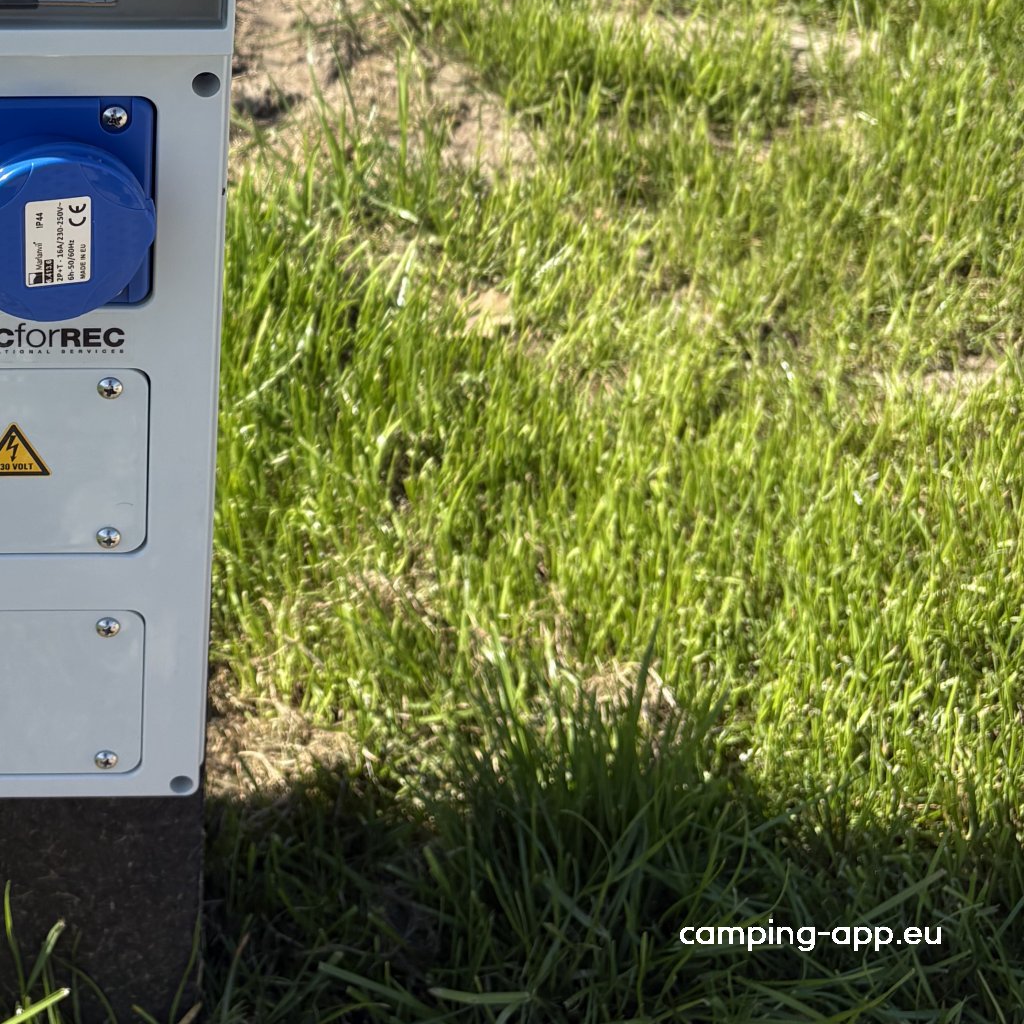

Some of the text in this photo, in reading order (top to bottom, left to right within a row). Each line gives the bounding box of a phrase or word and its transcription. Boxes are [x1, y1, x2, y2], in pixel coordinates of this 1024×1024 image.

[35, 212, 44, 229] IP44
[80, 243, 86, 255] EU
[68, 239, 76, 281] 6h-50/60Hz
